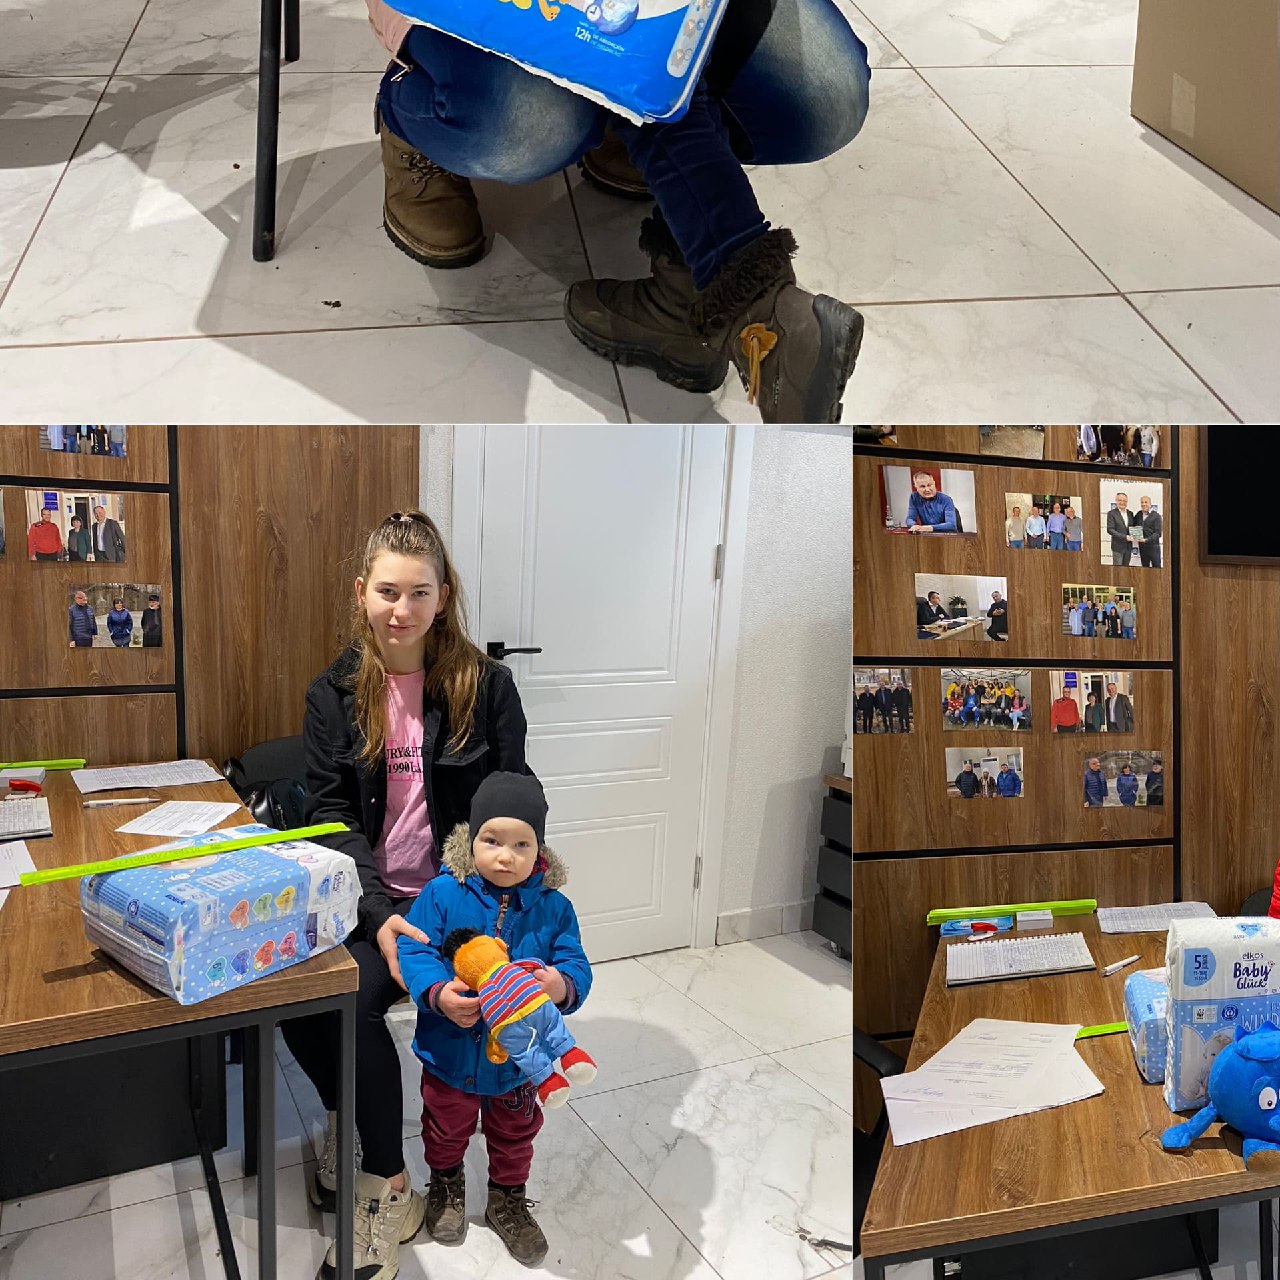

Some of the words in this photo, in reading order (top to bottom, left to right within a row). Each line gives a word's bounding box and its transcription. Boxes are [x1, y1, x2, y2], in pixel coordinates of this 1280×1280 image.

[574, 26, 592, 43] 12h
[1194, 954, 1202, 970] 5
[1233, 962, 1271, 981] Baby
[1236, 976, 1268, 990] Glück
